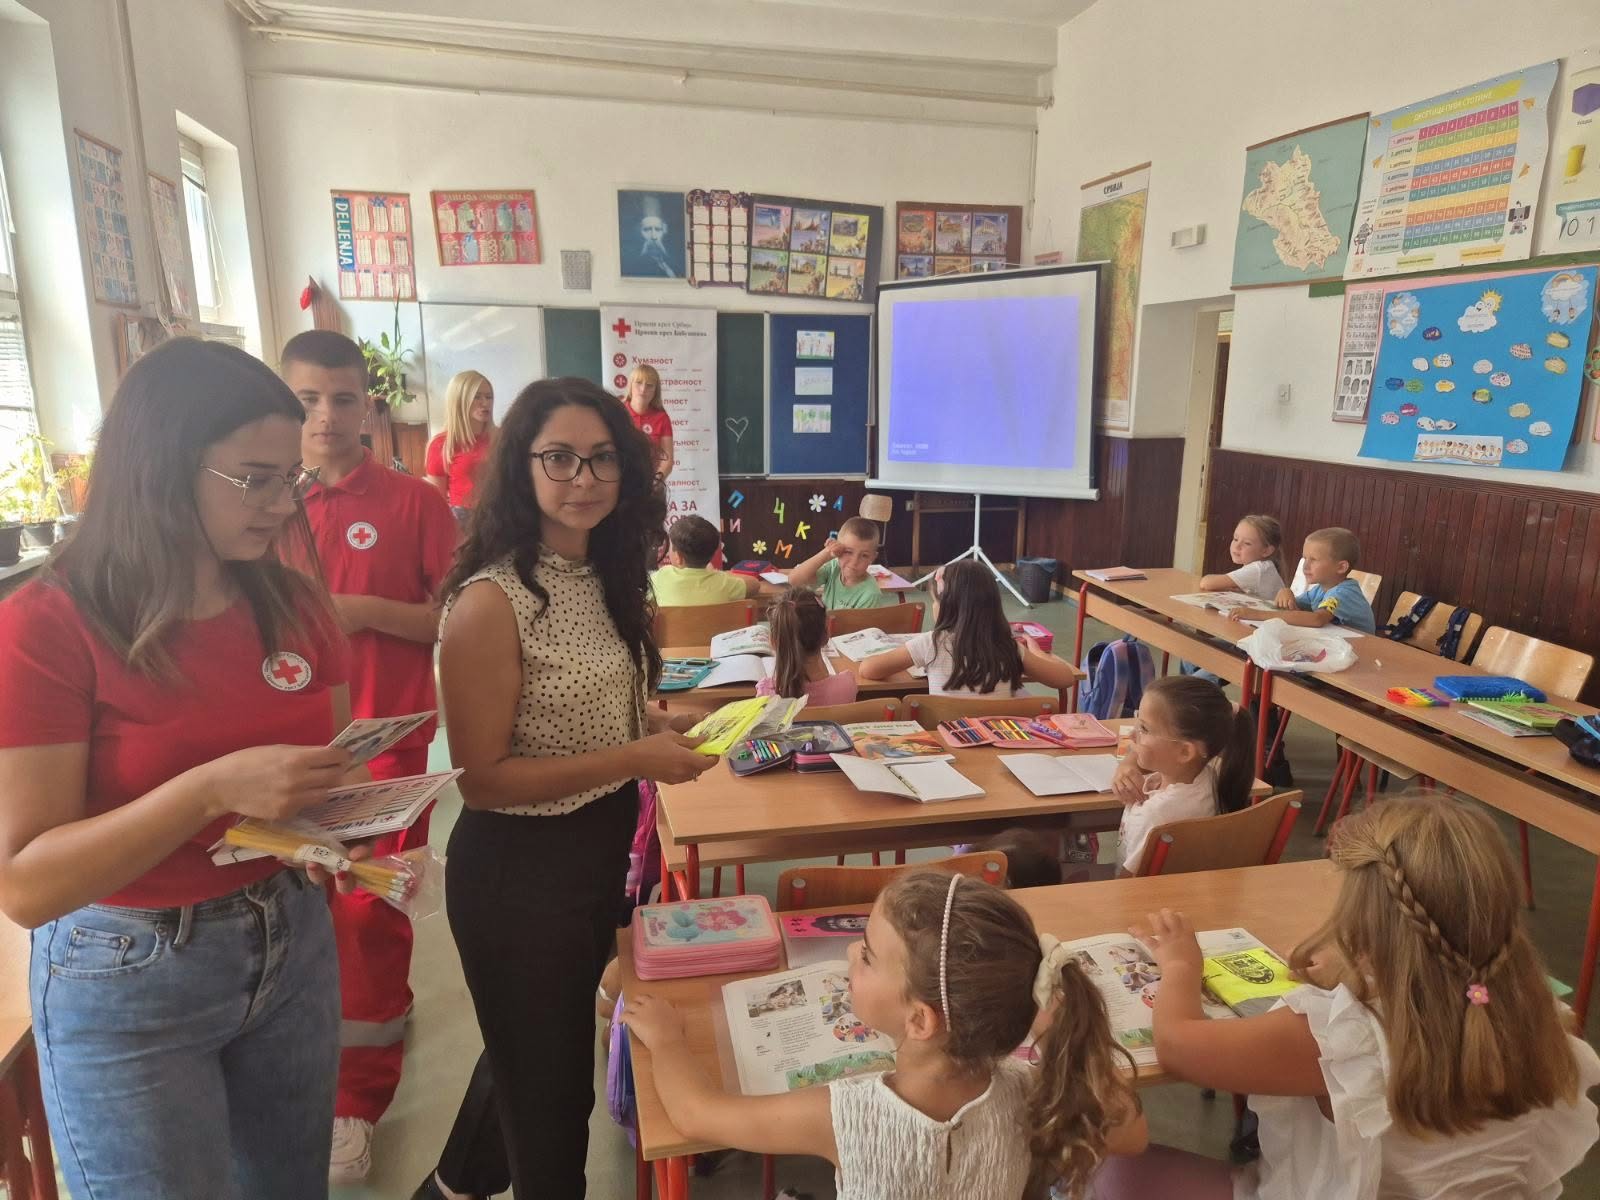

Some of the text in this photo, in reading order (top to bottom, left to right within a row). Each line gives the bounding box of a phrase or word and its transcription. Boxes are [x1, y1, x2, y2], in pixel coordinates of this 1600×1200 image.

[1103, 181, 1123, 194] СРБИЈА
[336, 203, 353, 265] DELJENJA
[632, 355, 673, 366] Хуманост
[681, 501, 697, 512] ЗА
[832, 495, 844, 512] А
[795, 521, 811, 540] К
[774, 539, 793, 559] М
